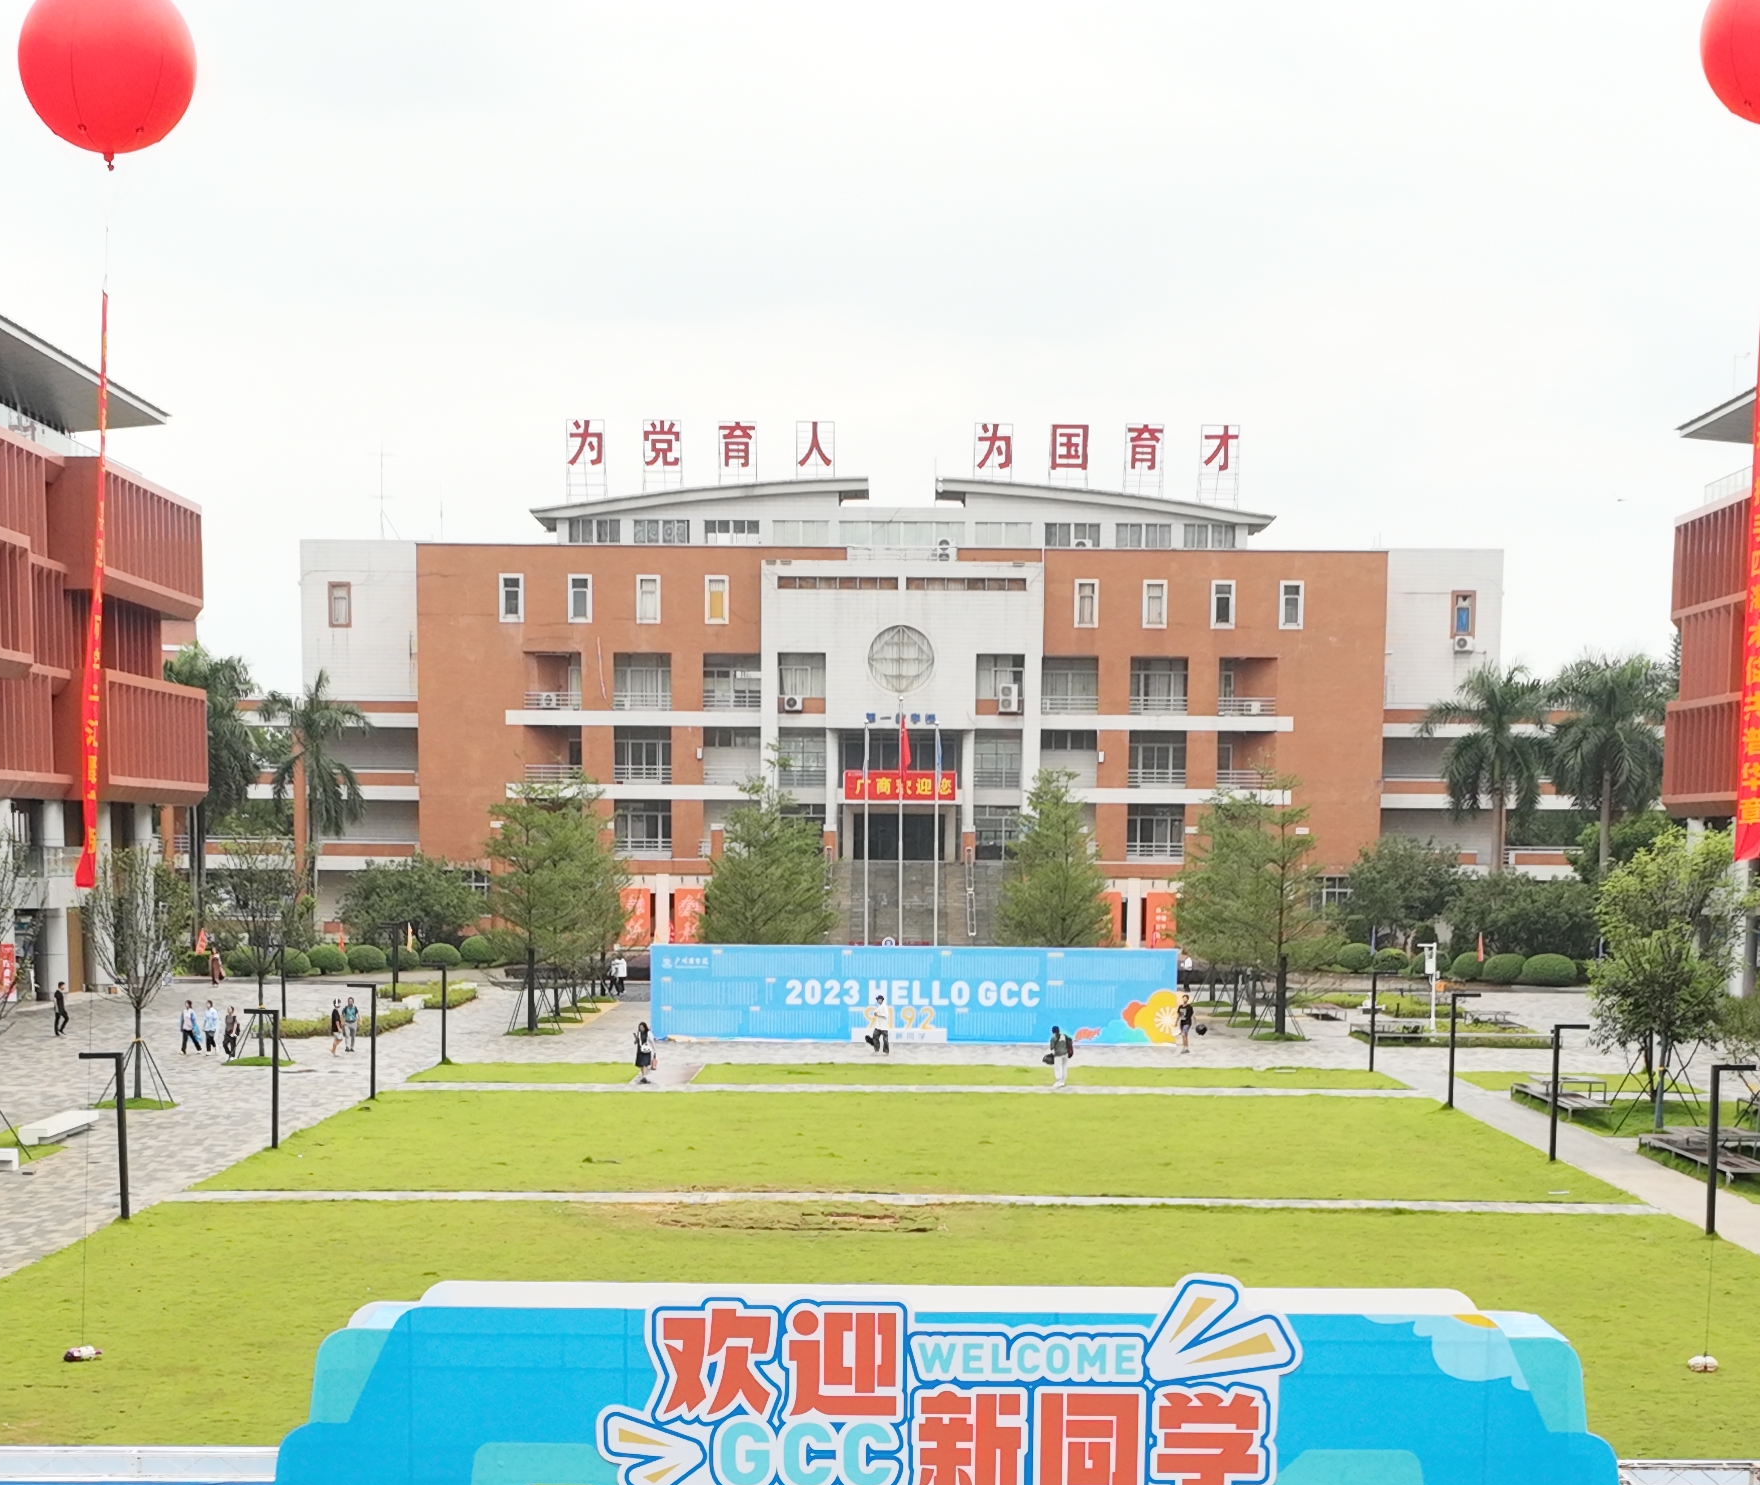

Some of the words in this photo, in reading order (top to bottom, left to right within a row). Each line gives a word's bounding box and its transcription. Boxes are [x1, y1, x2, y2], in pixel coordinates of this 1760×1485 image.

[567, 419, 834, 467] 为党育人
[976, 423, 1241, 472] 为国育才
[785, 979, 860, 1006] 2023
[869, 979, 970, 1006] HELLO
[977, 980, 1041, 1007] GCC
[655, 1305, 906, 1419] 欢迎
[915, 1335, 1144, 1382] WELCOME
